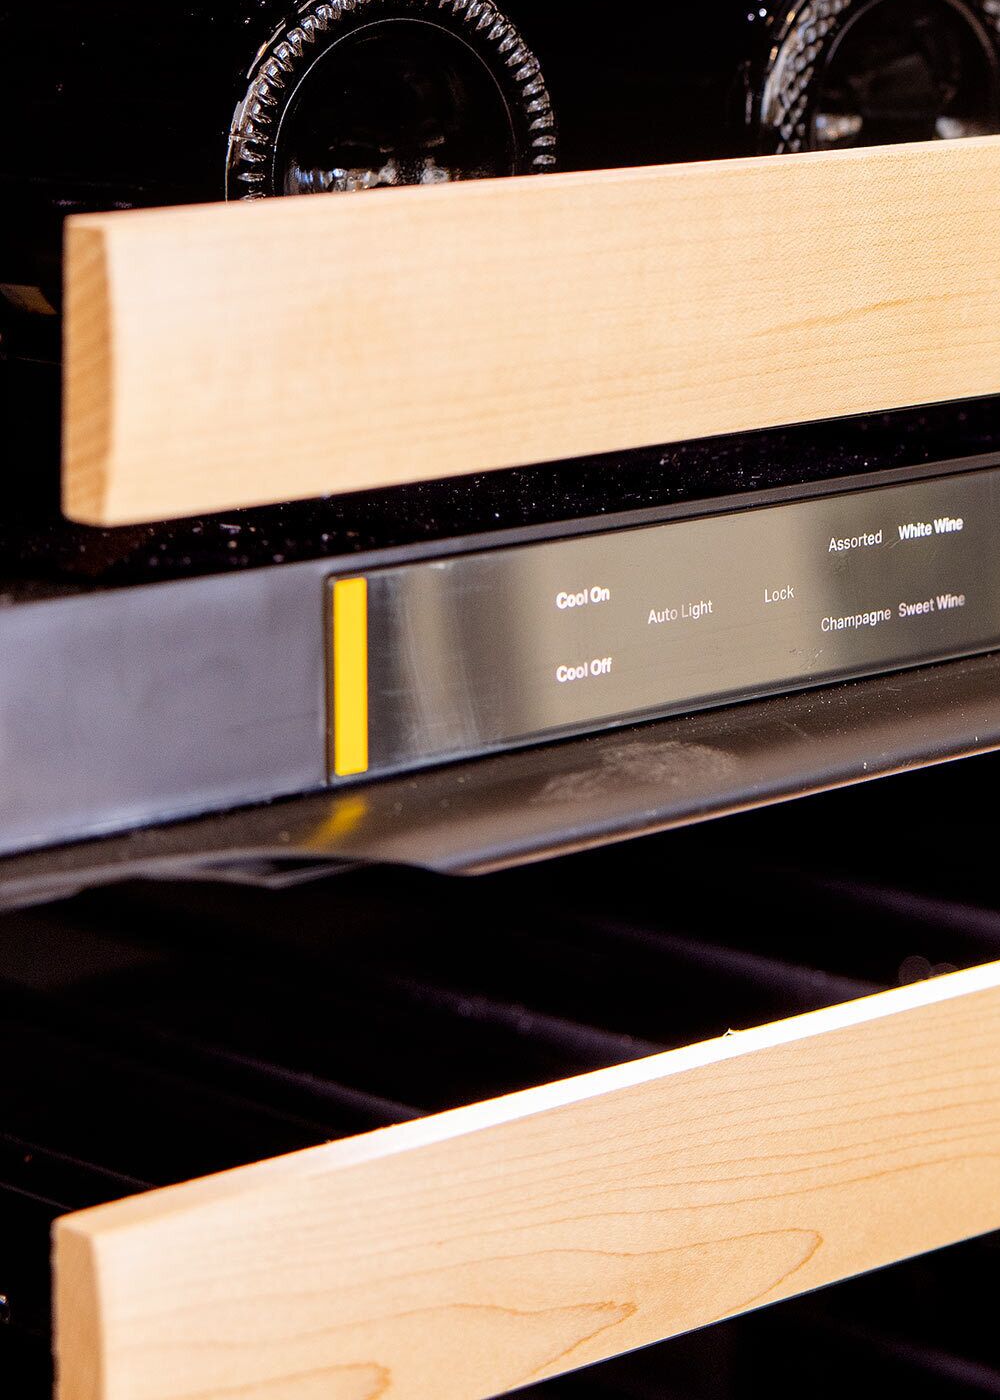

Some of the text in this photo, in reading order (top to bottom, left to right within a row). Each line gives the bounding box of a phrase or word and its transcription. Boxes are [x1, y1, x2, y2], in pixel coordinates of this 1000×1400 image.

[898, 516, 964, 541] White Wine
[828, 529, 883, 553] Assorted
[556, 586, 610, 610] Cool On
[764, 585, 795, 603] Lock
[898, 593, 966, 618] Sweet Wine
[647, 599, 713, 625] Auto Light
[820, 608, 892, 632] Champagne
[556, 656, 613, 683] Cool Off
